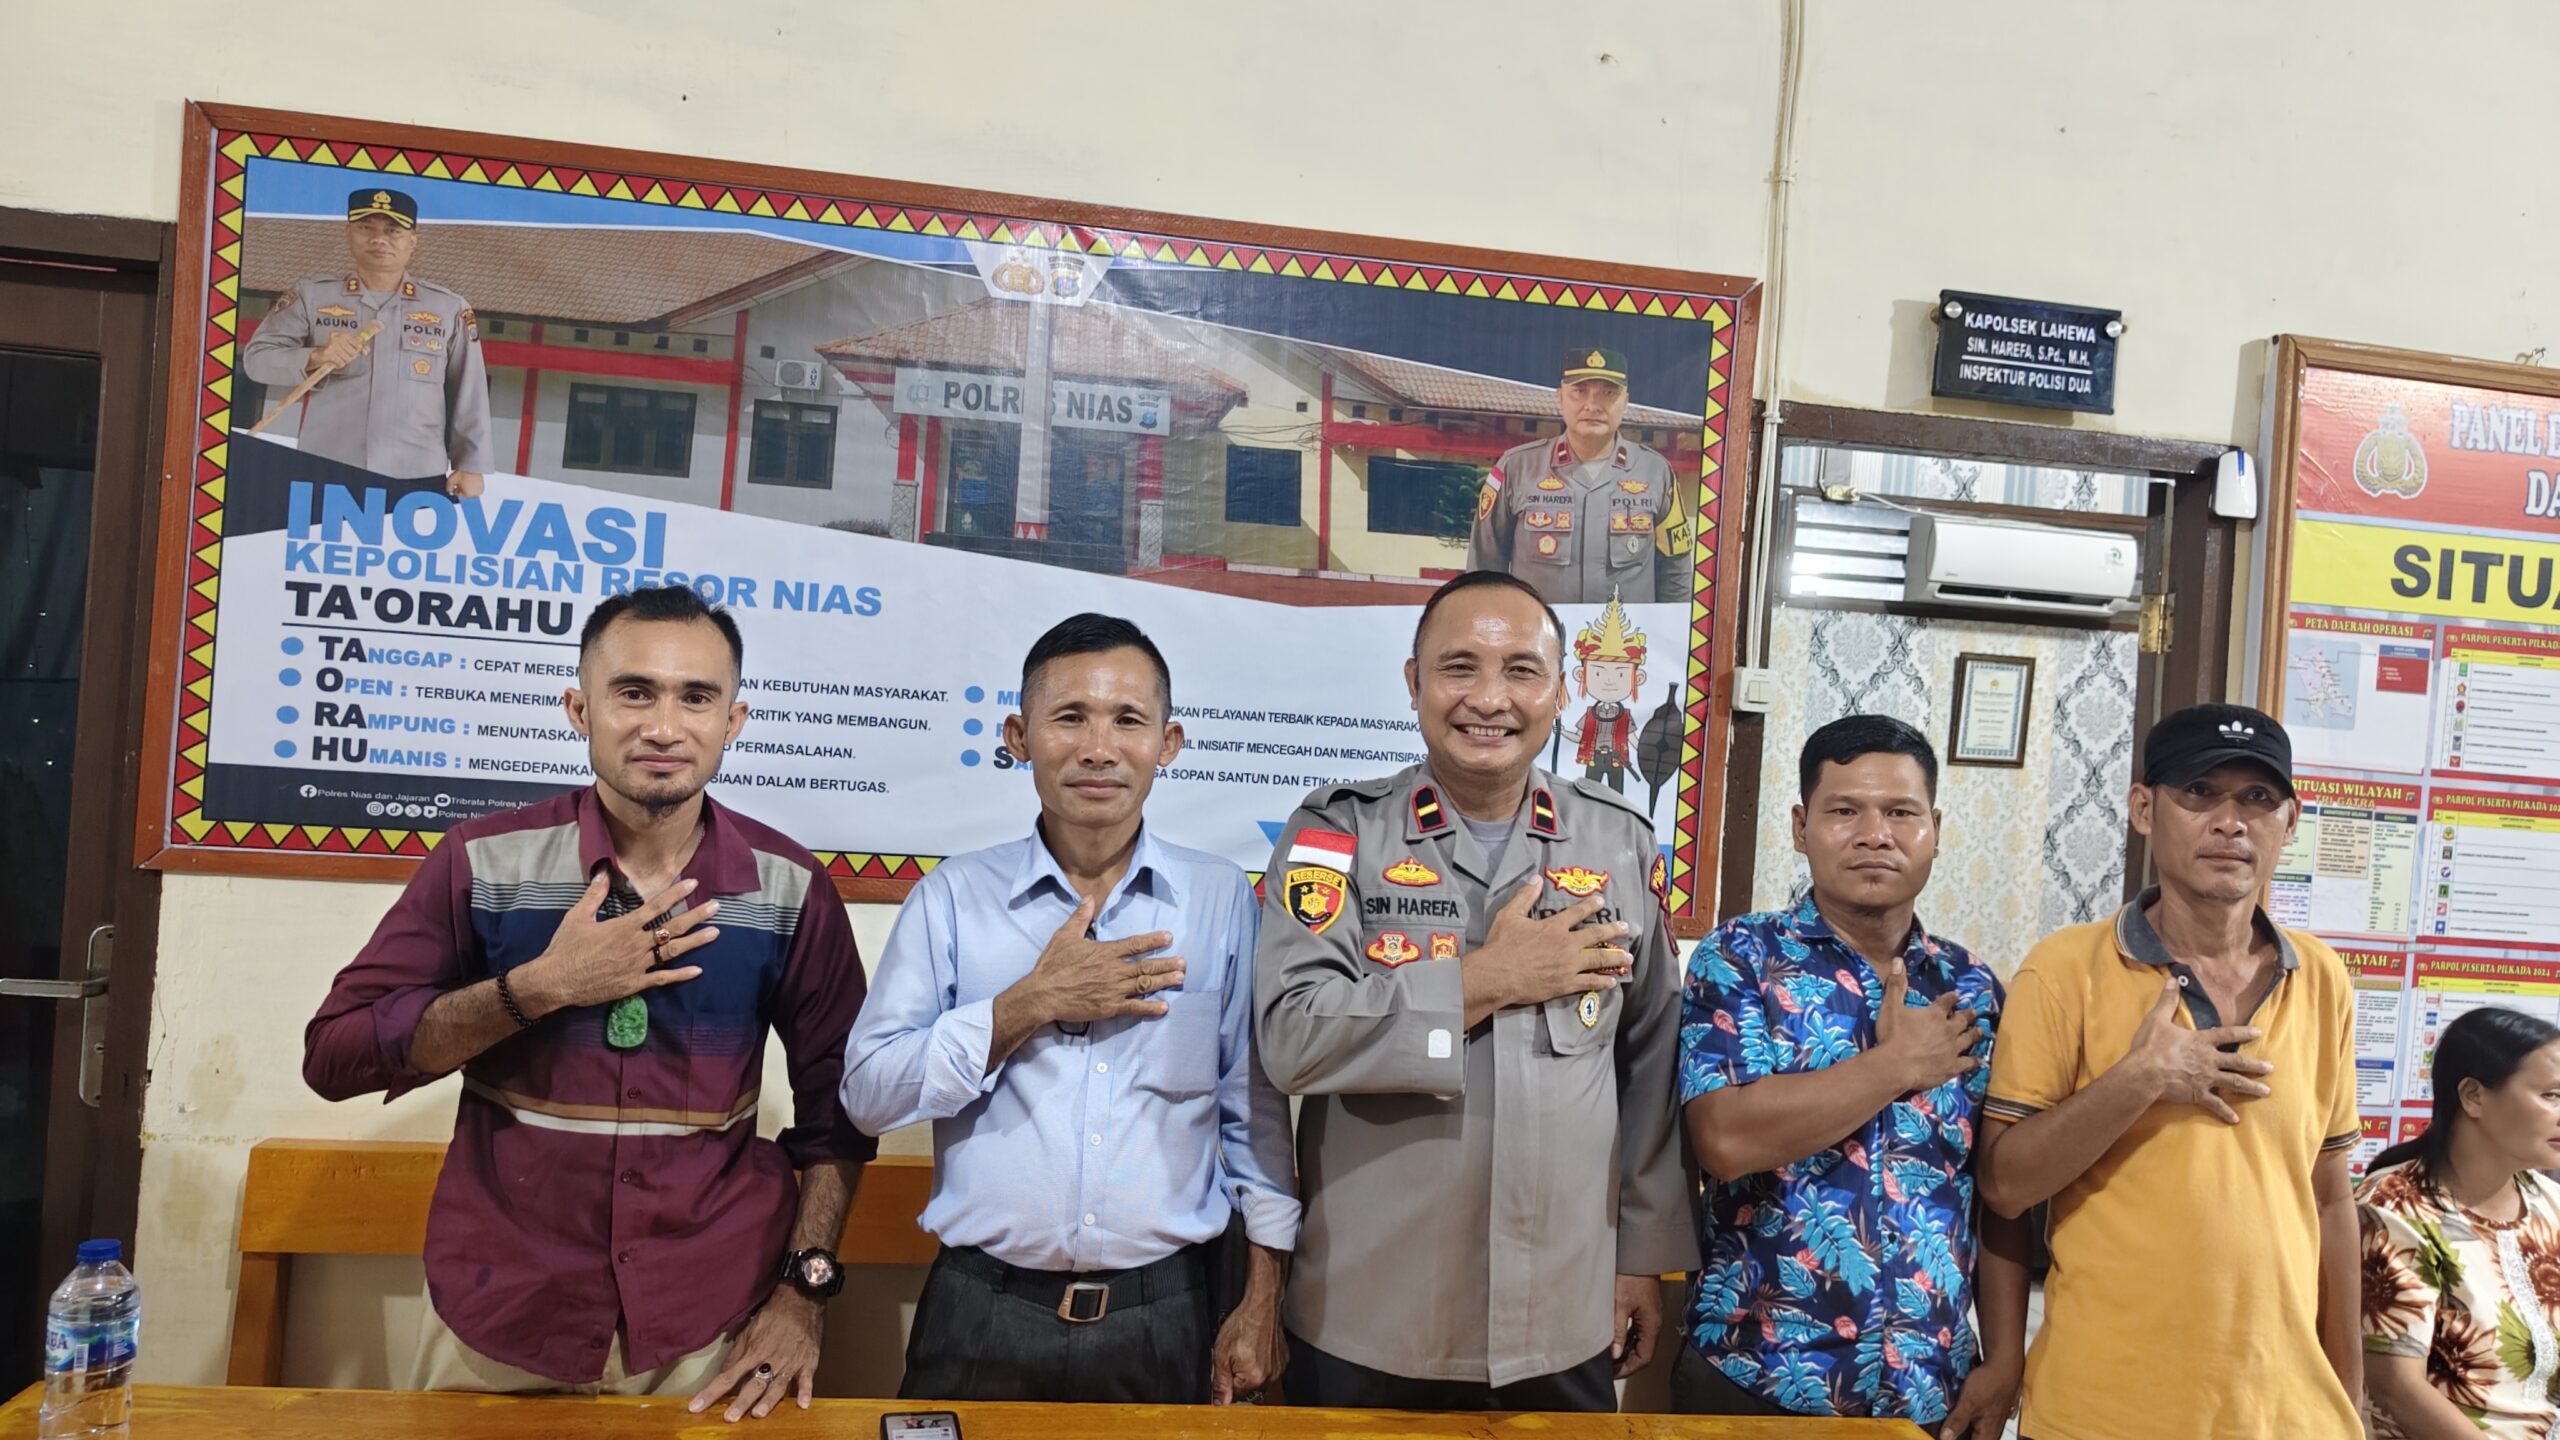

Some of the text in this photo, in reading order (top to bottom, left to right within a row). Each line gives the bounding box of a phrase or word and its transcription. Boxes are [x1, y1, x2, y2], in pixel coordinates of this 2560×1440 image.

[315, 317, 358, 329] AGUNG
[403, 324, 446, 338] POLRI
[1964, 311, 2097, 344] KAPOLSEK LAHEWA
[1967, 336, 1988, 353] SIN.
[1991, 340, 2035, 362] HAREFA,
[2068, 349, 2091, 367] M.H.
[1959, 363, 2092, 395] INSPEKTUR POLISI DUA
[943, 381, 1056, 417] POLR
[1067, 391, 1133, 424] NIAS
[2450, 401, 2542, 457] PANEL
[1612, 497, 1653, 508] POLRI
[286, 480, 668, 569] INOVASI
[285, 540, 585, 594] KEPOLISIAN
[773, 579, 883, 617] NIAS
[2390, 543, 2560, 610] SITU
[285, 580, 573, 636] TA'ORAHU
[2305, 617, 2414, 637] PETA DAERAH OPERASI
[2461, 633, 2560, 650] PARPOL PESERTA PILKAD
[318, 635, 453, 669] TANGGAP
[474, 659, 521, 673] CEPAT
[315, 667, 393, 697] OPEN
[415, 686, 487, 703] TERBUKA
[763, 679, 850, 697] KEBUTUHAN
[853, 685, 950, 702] MASYARAKAT.
[314, 701, 456, 735] RAMPUNG
[795, 711, 833, 725] YANG
[836, 714, 932, 731] MEMBANGUN.
[1202, 707, 1266, 723] PELAYANAN
[1268, 712, 1314, 726] TERBAIK
[1315, 715, 1359, 729] KEPADA
[311, 736, 447, 768] HUMANIS
[735, 741, 857, 760] PERMASALAHAN.
[1197, 739, 1245, 752] INISIATIF
[1247, 742, 1312, 757] MENCEGAH
[1314, 746, 1338, 758] DAN
[756, 775, 806, 789] DALAM
[810, 778, 890, 793] BERTUGAS.
[1171, 769, 1215, 782] SOPAN
[1218, 771, 1270, 785] SANTUN
[1273, 774, 1299, 786] DAN
[317, 789, 348, 798] Polres
[350, 790, 373, 799] Nias
[374, 792, 393, 800] dan
[2292, 779, 2402, 800] SITUASI WILAYAH
[488, 798, 517, 808] Polres
[2446, 794, 2475, 806] PARPOL
[2477, 796, 2511, 809] PESERTA
[2512, 799, 2548, 812] PILKADA
[438, 810, 468, 819] Polres
[1292, 870, 1341, 887] RESERSE
[1366, 896, 1460, 919] SIN HAREFA
[2431, 960, 2460, 972] PARPOL
[2461, 962, 2495, 974] PESERTA
[2497, 964, 2532, 976] PILKADA
